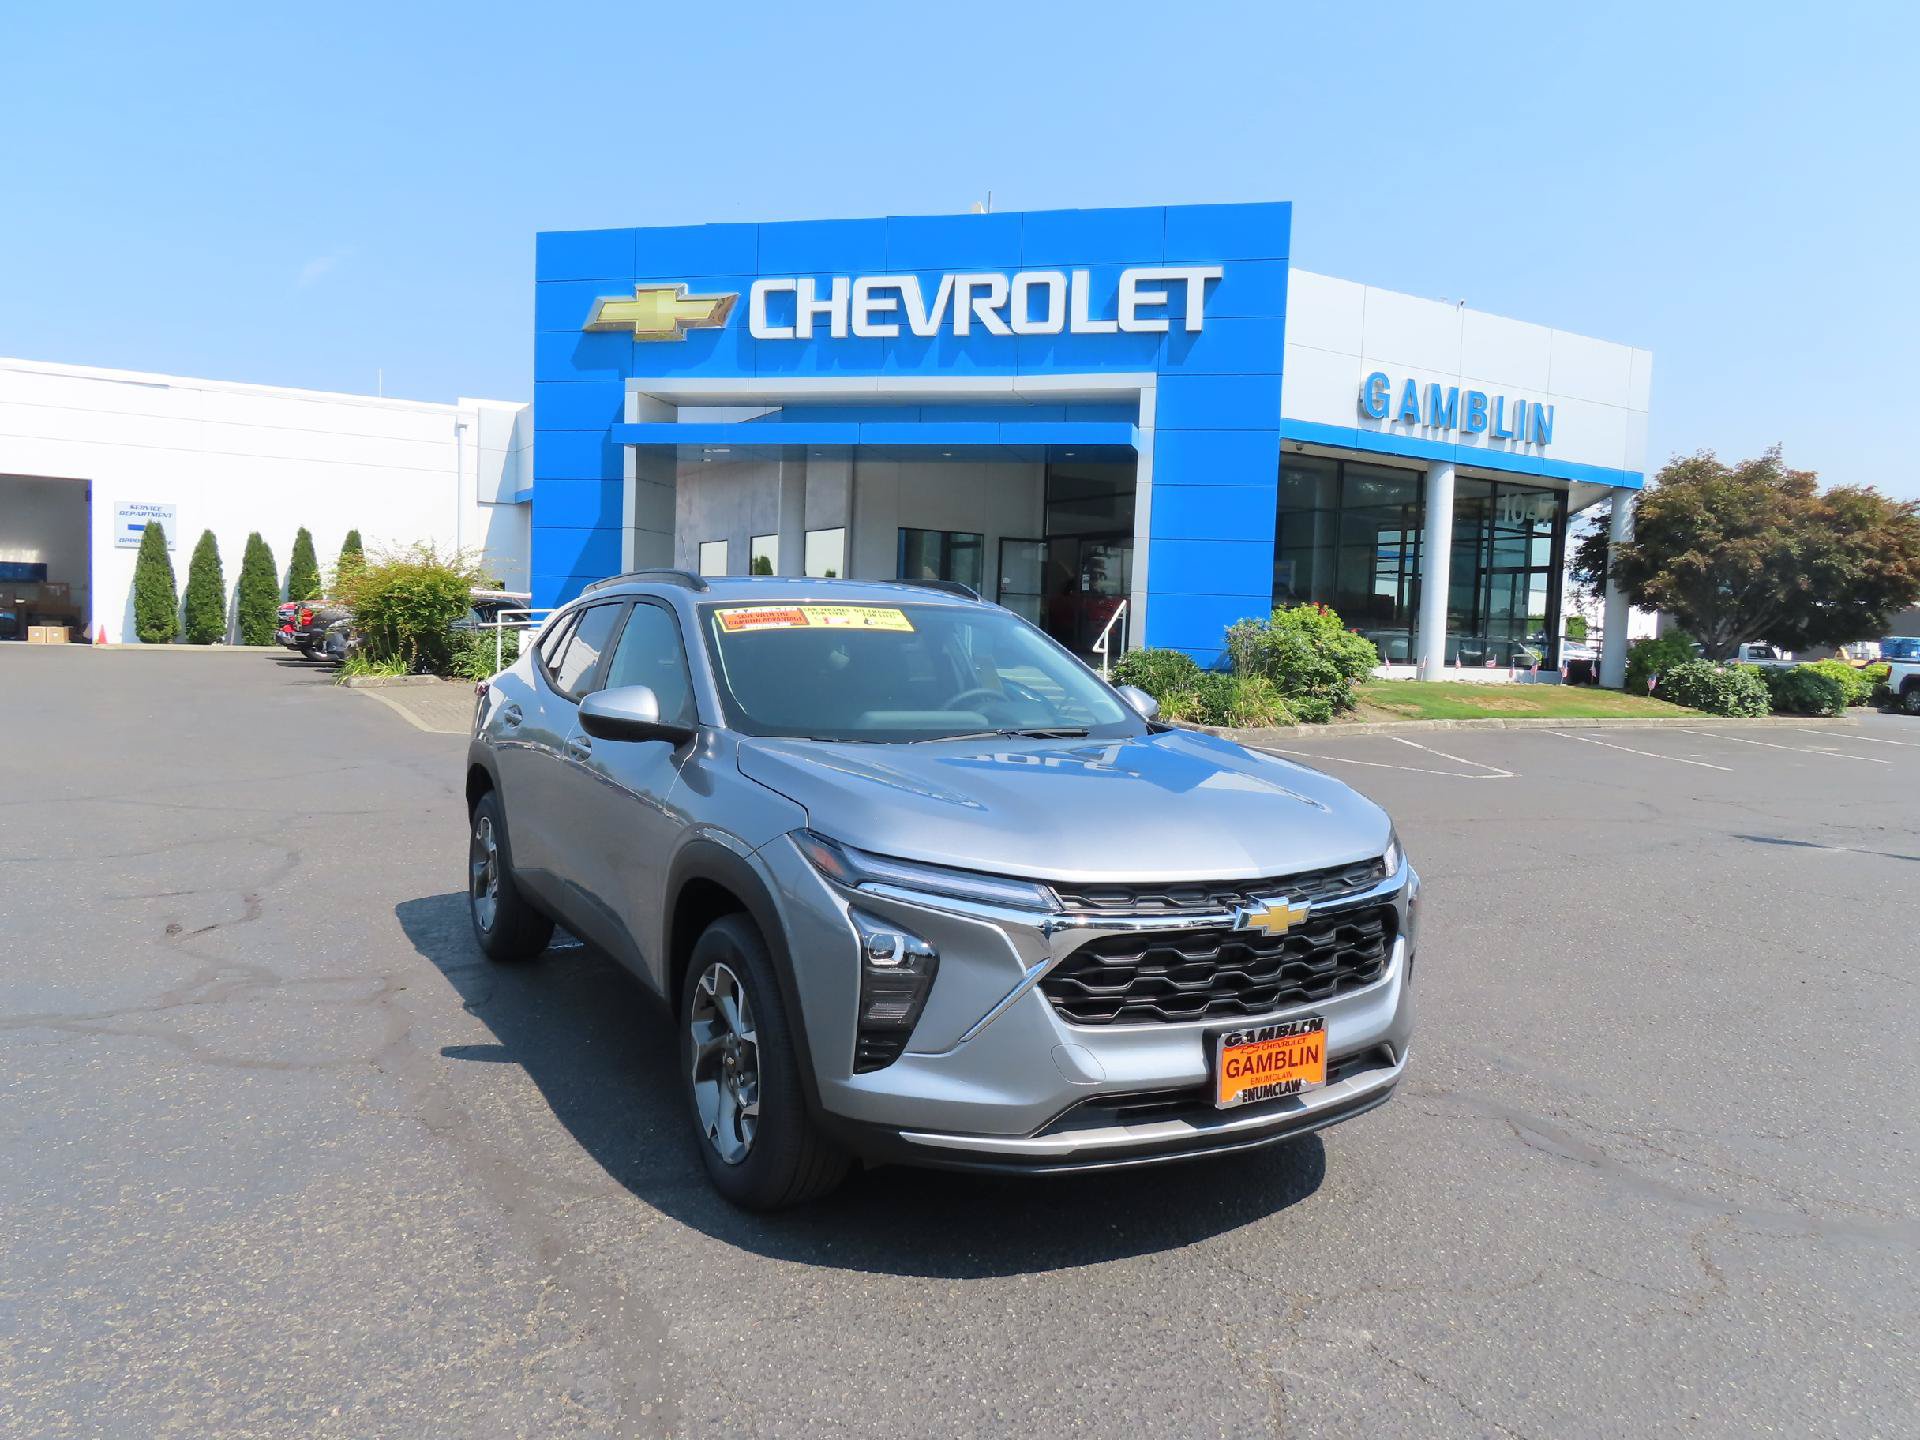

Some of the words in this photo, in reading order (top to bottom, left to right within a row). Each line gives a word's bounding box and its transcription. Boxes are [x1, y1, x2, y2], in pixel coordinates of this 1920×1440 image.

[749, 266, 1224, 339] CHEVROLET
[1360, 371, 1555, 445] GAMBLIN
[118, 510, 173, 518] DEPARTMENT
[1224, 1018, 1324, 1047] GAMBLIN
[1262, 1038, 1306, 1051] CHEVROLET
[1226, 1045, 1319, 1078] GAMBLIN
[1242, 1079, 1302, 1103] ENUMCLAW
[1250, 1071, 1293, 1086] ENUMCLAW
